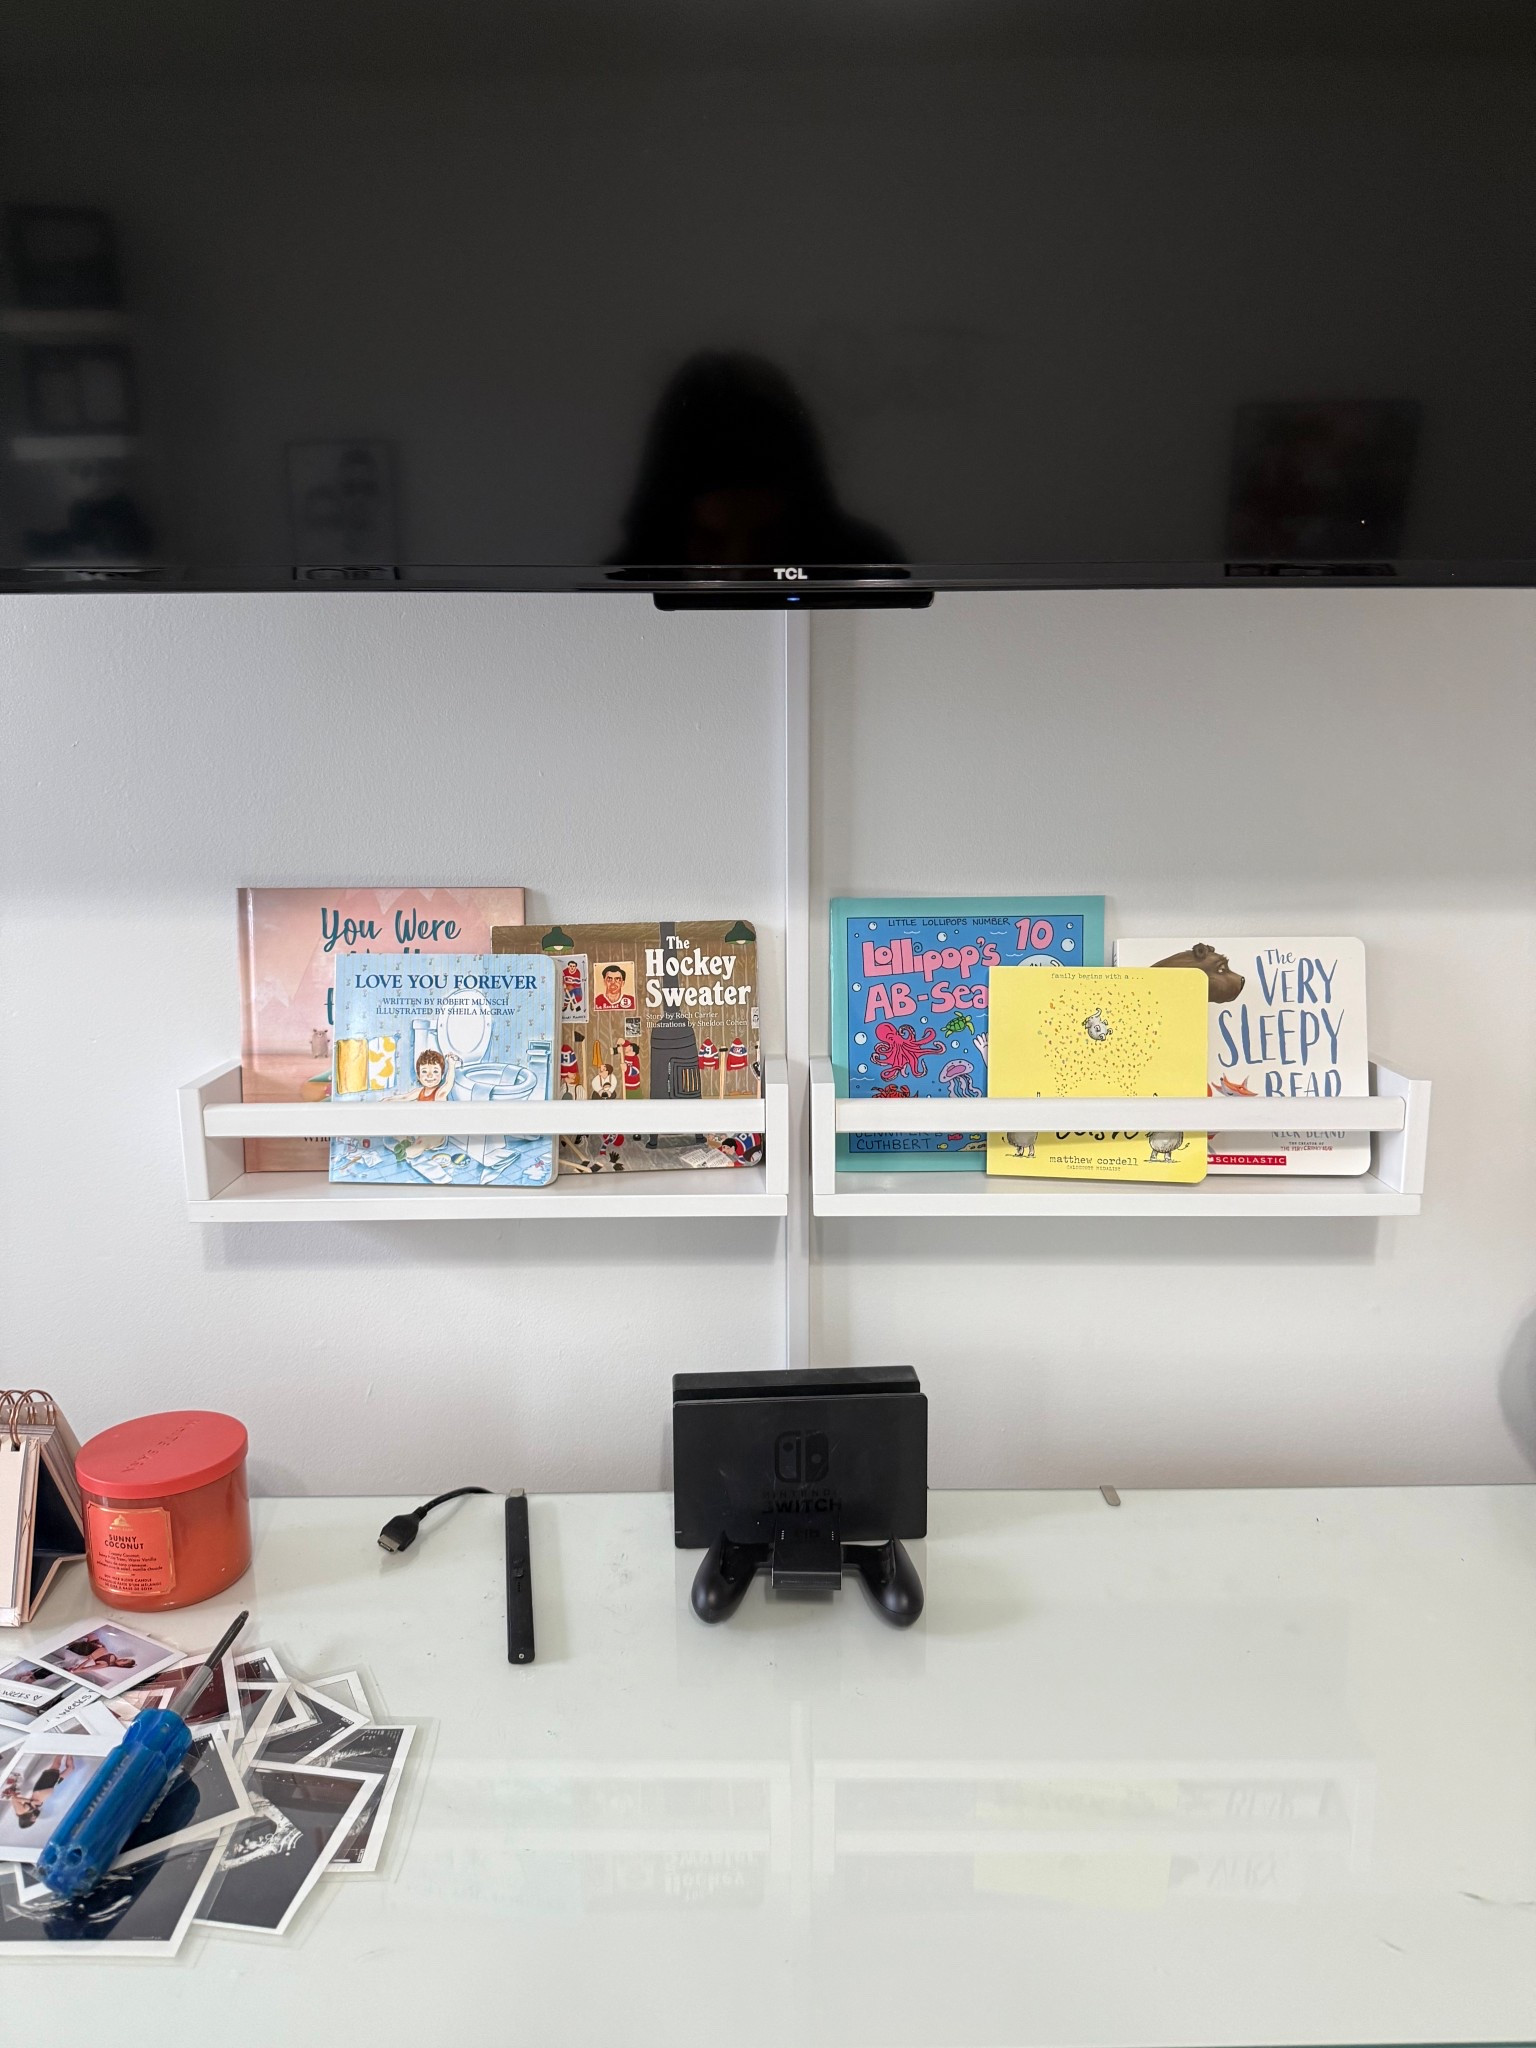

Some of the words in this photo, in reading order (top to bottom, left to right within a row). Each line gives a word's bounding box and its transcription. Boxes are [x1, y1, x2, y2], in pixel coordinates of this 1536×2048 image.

[773, 567, 808, 580] TCL
[321, 907, 382, 952] You
[395, 907, 461, 944] Were
[888, 918, 917, 927] LITTLE
[922, 918, 968, 926] LOLLIPOPS
[972, 917, 1011, 926] NUMBER
[1014, 917, 1054, 950] 10
[666, 935, 690, 949] The
[861, 936, 1001, 983] Lollipop's
[1264, 948, 1296, 965] The
[645, 947, 737, 980] Hockey
[355, 974, 403, 989] LOVE
[407, 974, 448, 989] YOU
[454, 974, 538, 989] FOREVER
[1051, 973, 1076, 981] family
[1078, 973, 1103, 981] begins
[1256, 955, 1338, 1006] VERY
[645, 979, 752, 1008] Sweater
[382, 997, 422, 1006] WRITTEN
[424, 997, 436, 1006] BY
[437, 997, 470, 1006] ROBERT
[471, 997, 509, 1006] MUNSCH
[376, 1007, 433, 1016] ILLUSTRATED
[435, 1007, 446, 1015] BY
[447, 1007, 477, 1016] SHEILA
[480, 1007, 515, 1016] McGRAW
[646, 1013, 664, 1021] Story
[665, 1012, 674, 1020] by
[675, 1011, 693, 1019] Roch
[694, 1011, 718, 1019] Carrier
[646, 1020, 686, 1028] Illustrations
[687, 1020, 695, 1028] by
[697, 1018, 724, 1027] Sheldon
[726, 1018, 748, 1026] Cohen
[1217, 1004, 1345, 1068] SLEEPY
[857, 1138, 931, 1151] CUTHBERT
[1049, 1155, 1092, 1164] matthew
[1096, 1156, 1138, 1166] cordell
[1215, 1155, 1286, 1165] SCHOLASTIC
[105, 1540, 144, 1549] COCONUT
[109, 1534, 137, 1543] SUNNY
